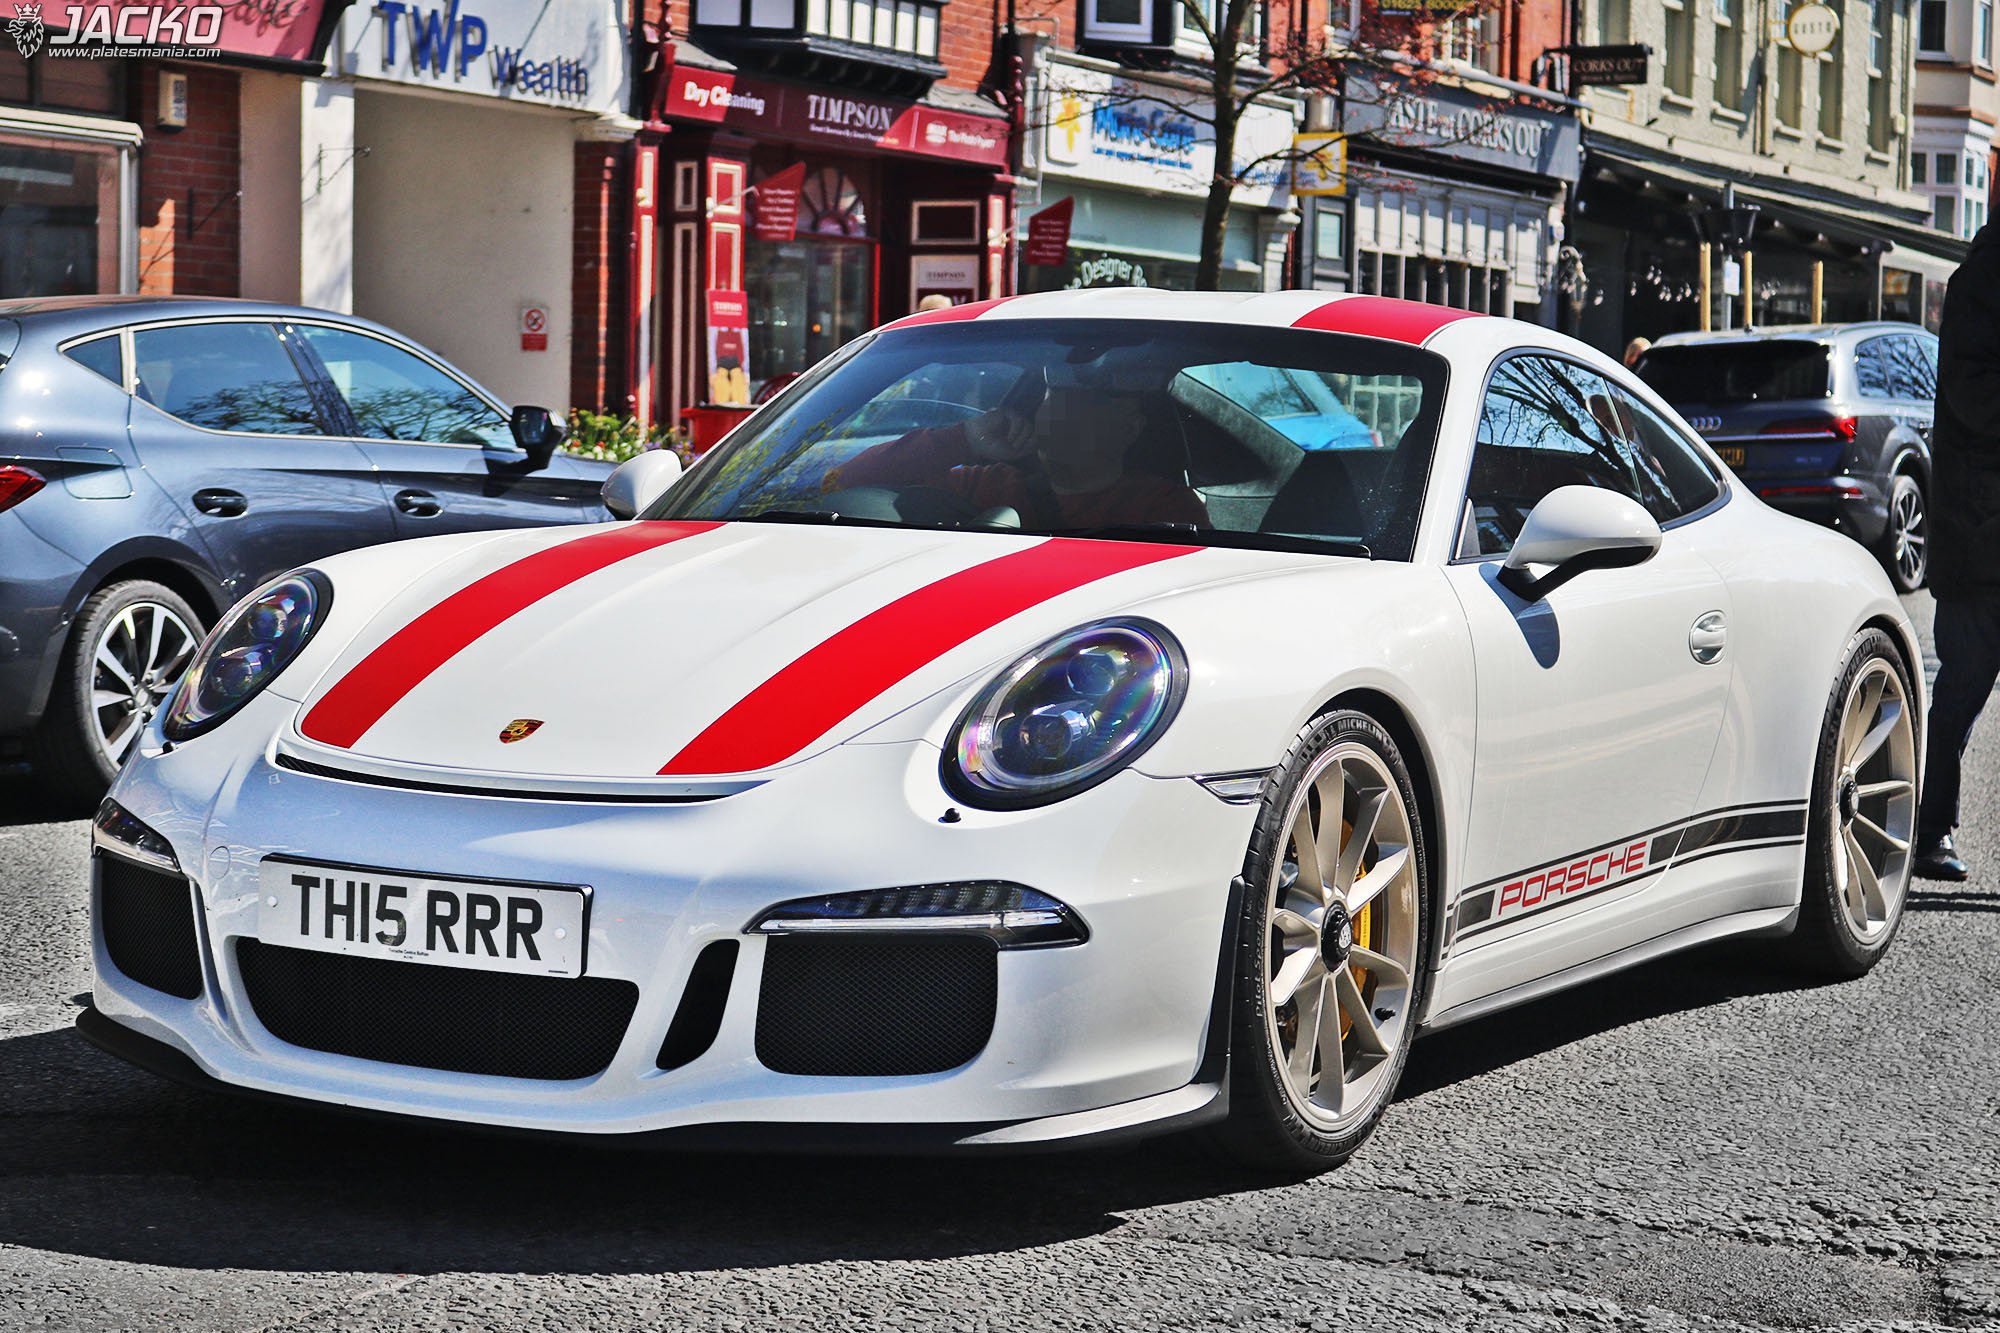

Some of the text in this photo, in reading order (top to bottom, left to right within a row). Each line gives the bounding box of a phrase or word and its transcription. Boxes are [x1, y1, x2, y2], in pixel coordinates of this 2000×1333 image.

[373, 0, 488, 80] TWP
[488, 45, 588, 101] Wealth
[1573, 57, 1646, 73] CORKS OUT
[684, 80, 766, 116] Dry Cleaning
[806, 94, 893, 131] TIMPSON
[1386, 97, 1439, 134] ASTE
[1080, 252, 1133, 287] Designer
[1337, 717, 1384, 742] MICHELIN
[1498, 840, 1648, 916] PORSCHE
[425, 889, 544, 961] RRR
[1254, 917, 1265, 972] Sport
[1253, 975, 1264, 1018] Pilot
